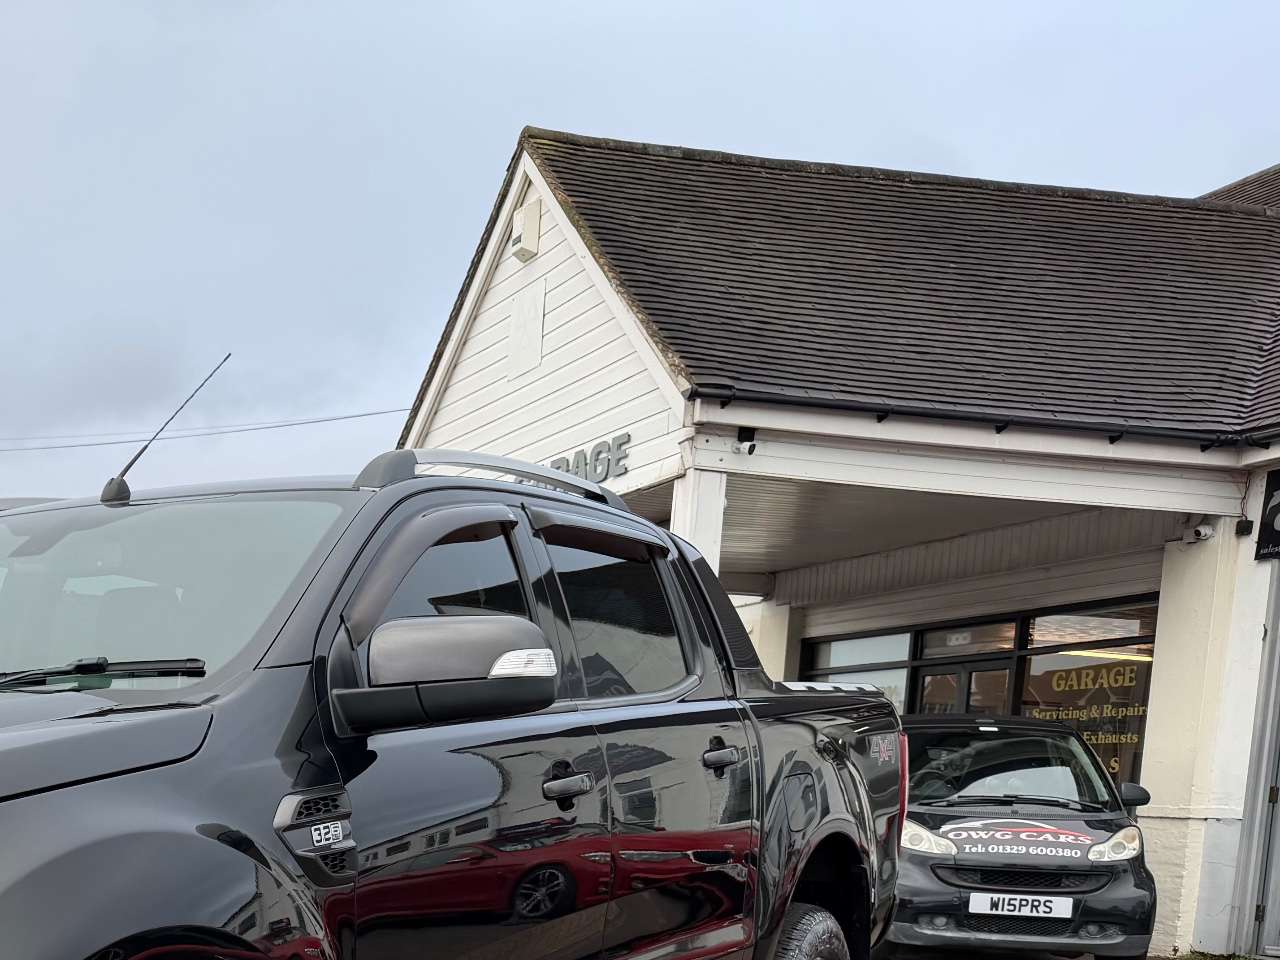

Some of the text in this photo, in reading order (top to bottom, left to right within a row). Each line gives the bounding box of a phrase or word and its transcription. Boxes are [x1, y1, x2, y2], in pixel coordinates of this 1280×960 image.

[1052, 665, 1137, 692] GARAGE
[1032, 706, 1088, 721] Servicing
[1089, 704, 1100, 718] &
[1082, 731, 1139, 745] Exhausts
[947, 830, 1093, 845] OWG CARS
[964, 844, 1081, 858] Tel: 01329 600380
